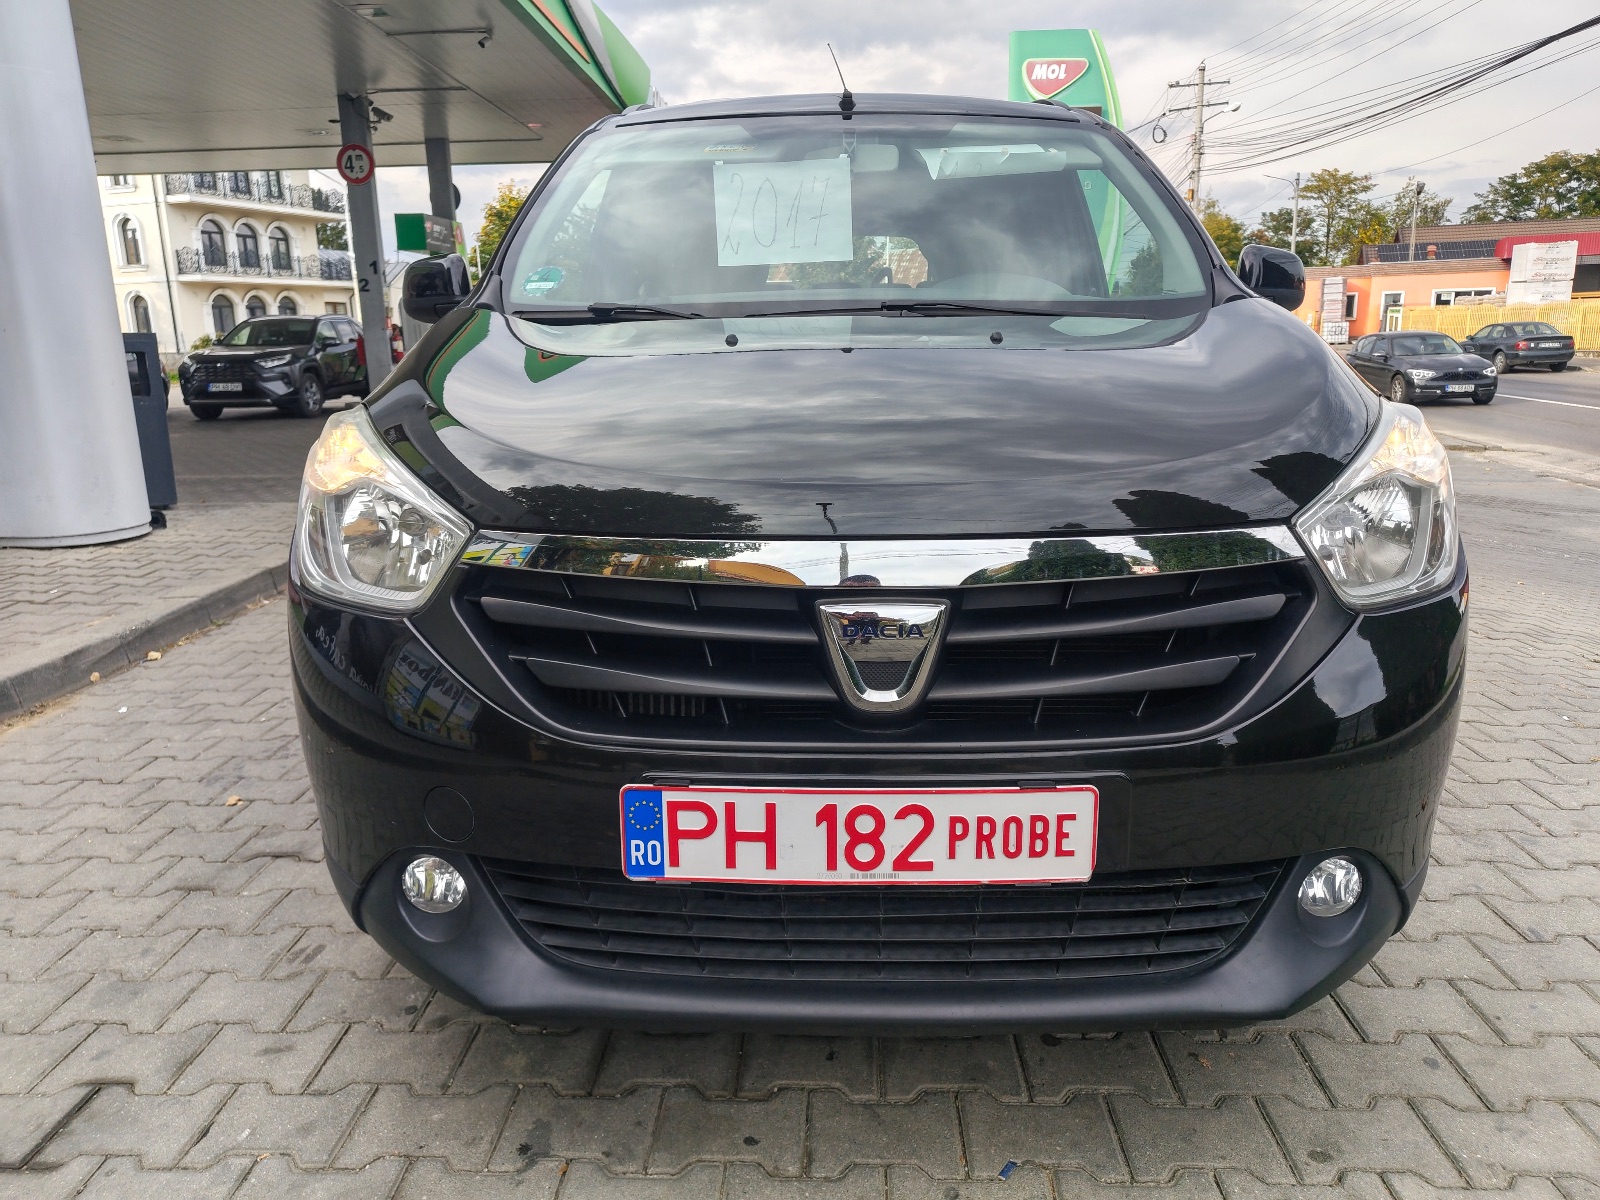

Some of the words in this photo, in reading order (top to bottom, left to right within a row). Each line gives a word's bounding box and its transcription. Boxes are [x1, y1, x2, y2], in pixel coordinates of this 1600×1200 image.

[1030, 63, 1067, 80] MOL
[721, 173, 831, 255] 2017
[369, 260, 378, 275] 1
[358, 278, 370, 292] 2
[842, 623, 925, 640] DACIA
[666, 800, 778, 871] PH
[814, 803, 935, 873] 182
[947, 812, 1077, 860] PROBE
[630, 839, 662, 866] RO
